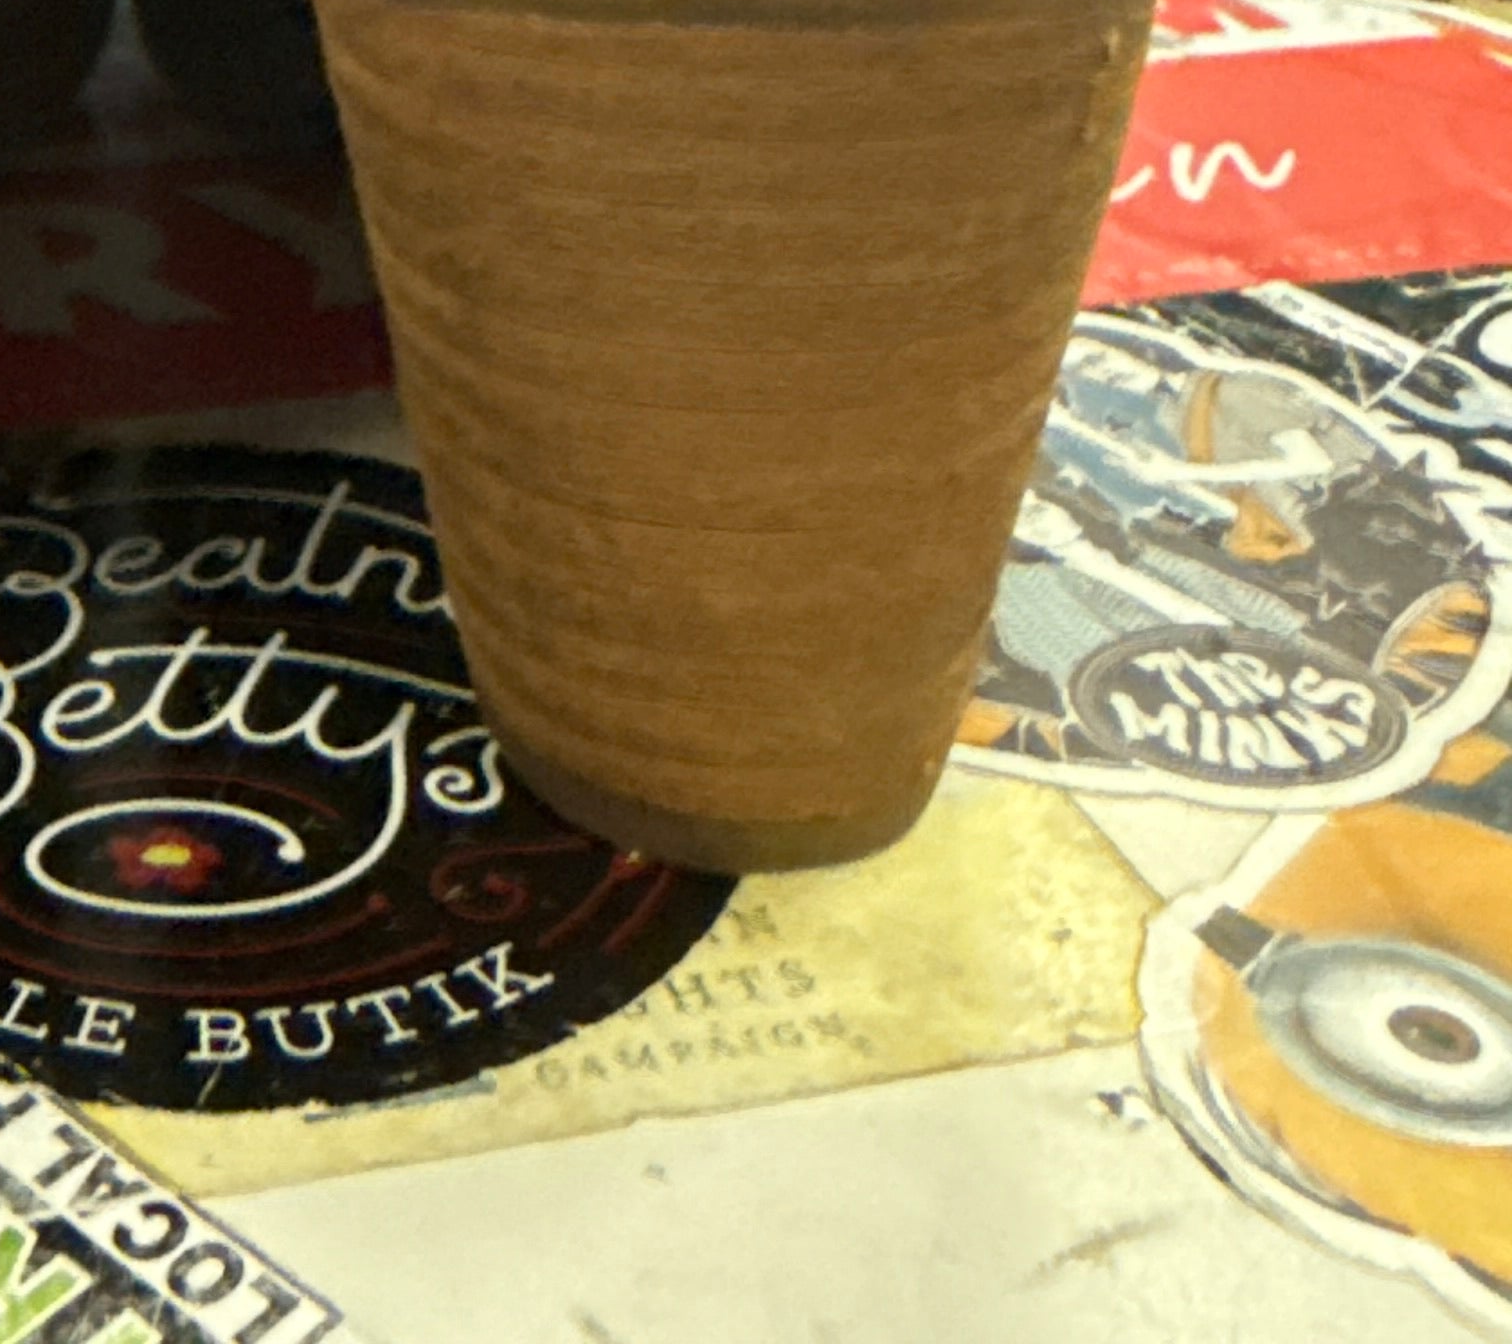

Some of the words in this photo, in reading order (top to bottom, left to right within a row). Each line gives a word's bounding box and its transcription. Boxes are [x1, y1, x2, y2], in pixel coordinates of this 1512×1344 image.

[1108, 665, 1378, 772] MINKS
[183, 942, 555, 1063] BUTIK
[624, 956, 818, 1018] HTS
